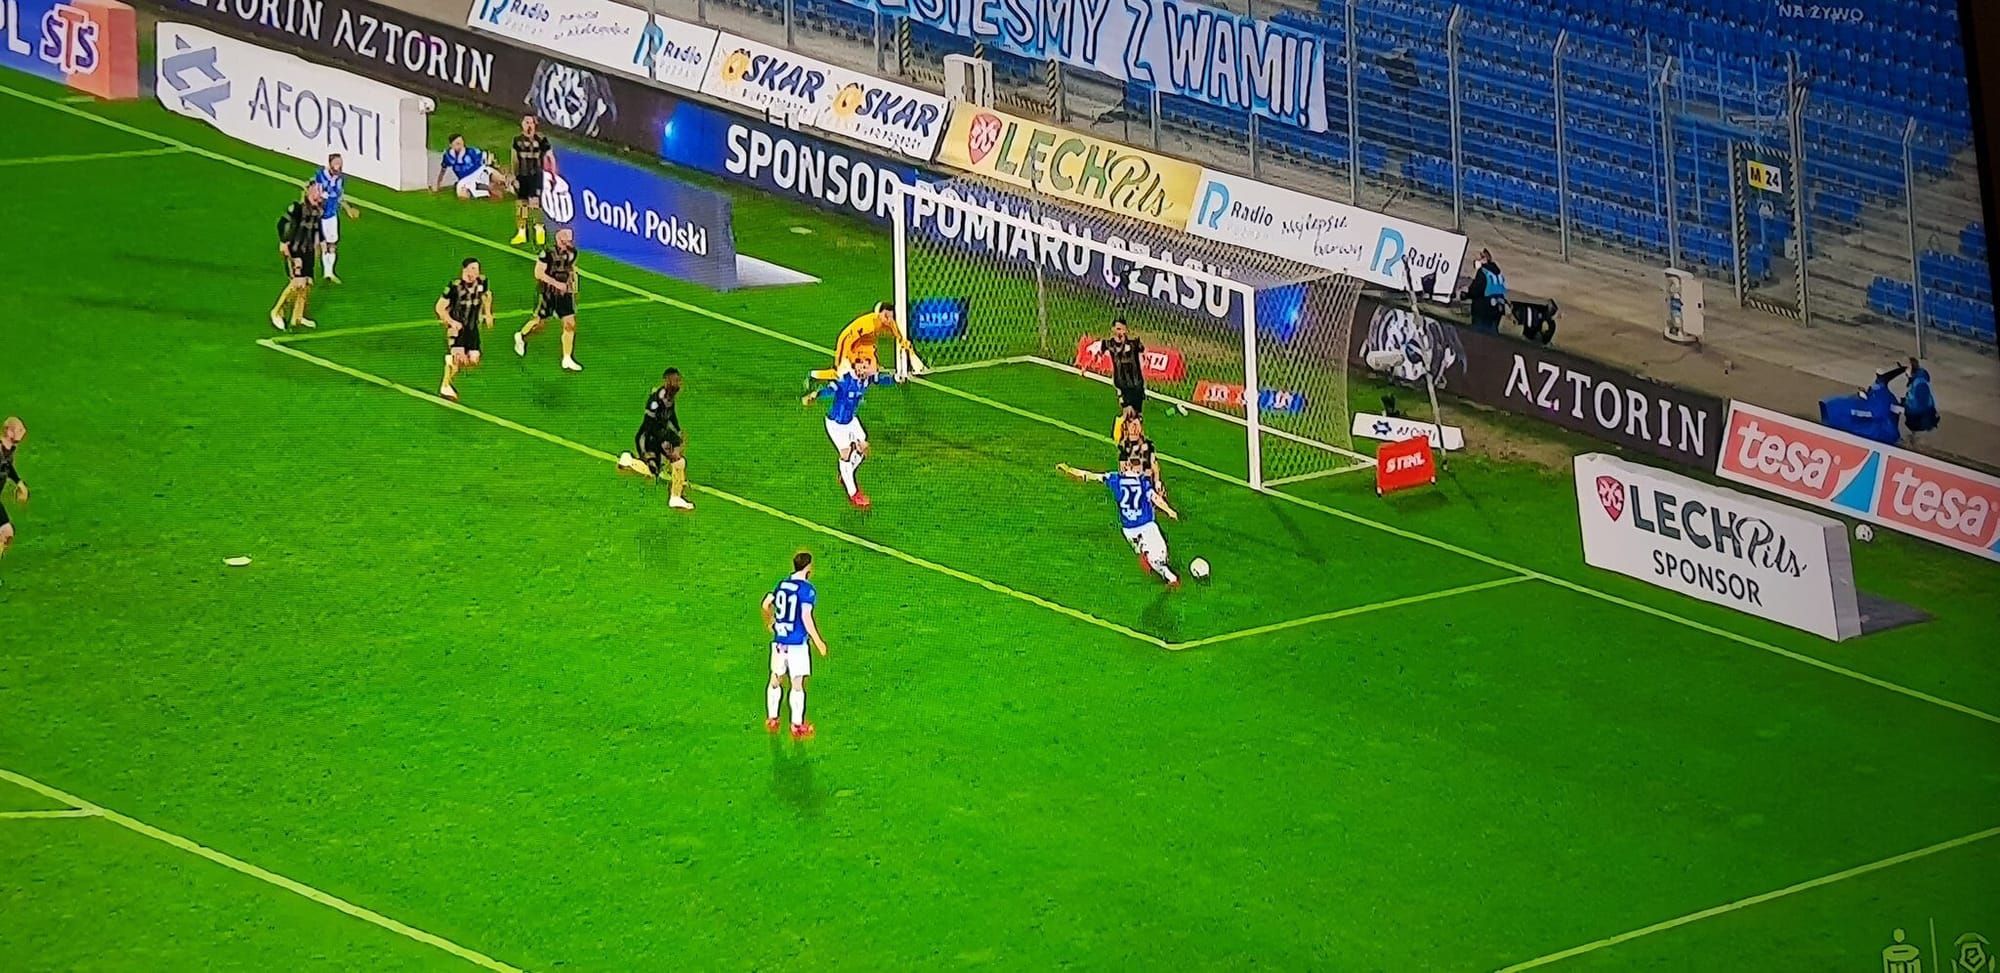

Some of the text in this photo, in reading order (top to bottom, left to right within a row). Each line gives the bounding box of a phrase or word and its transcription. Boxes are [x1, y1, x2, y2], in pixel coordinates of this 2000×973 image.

[40, 3, 99, 75] STS
[332, 8, 495, 93] AZTORIN
[1124, 0, 1155, 82] Z
[1163, 6, 1312, 126] WAMI!
[248, 76, 381, 162] AFORTI
[724, 124, 902, 220] SPONSOR
[913, 179, 1094, 277] POMIARU
[994, 121, 1175, 218] LECH Pils
[1750, 166, 1780, 188] M 24
[583, 189, 639, 236] Bank
[645, 210, 708, 256] Polski
[1230, 201, 1274, 228] Radio
[1407, 246, 1450, 275] Radio
[1504, 353, 1708, 457] AZTORIN
[1119, 485, 1143, 511] 27
[1738, 420, 1990, 538] tesa tesa
[1629, 484, 1807, 578] LECH Pils
[774, 590, 798, 622] 91
[1653, 550, 1763, 608] SPONSOR
